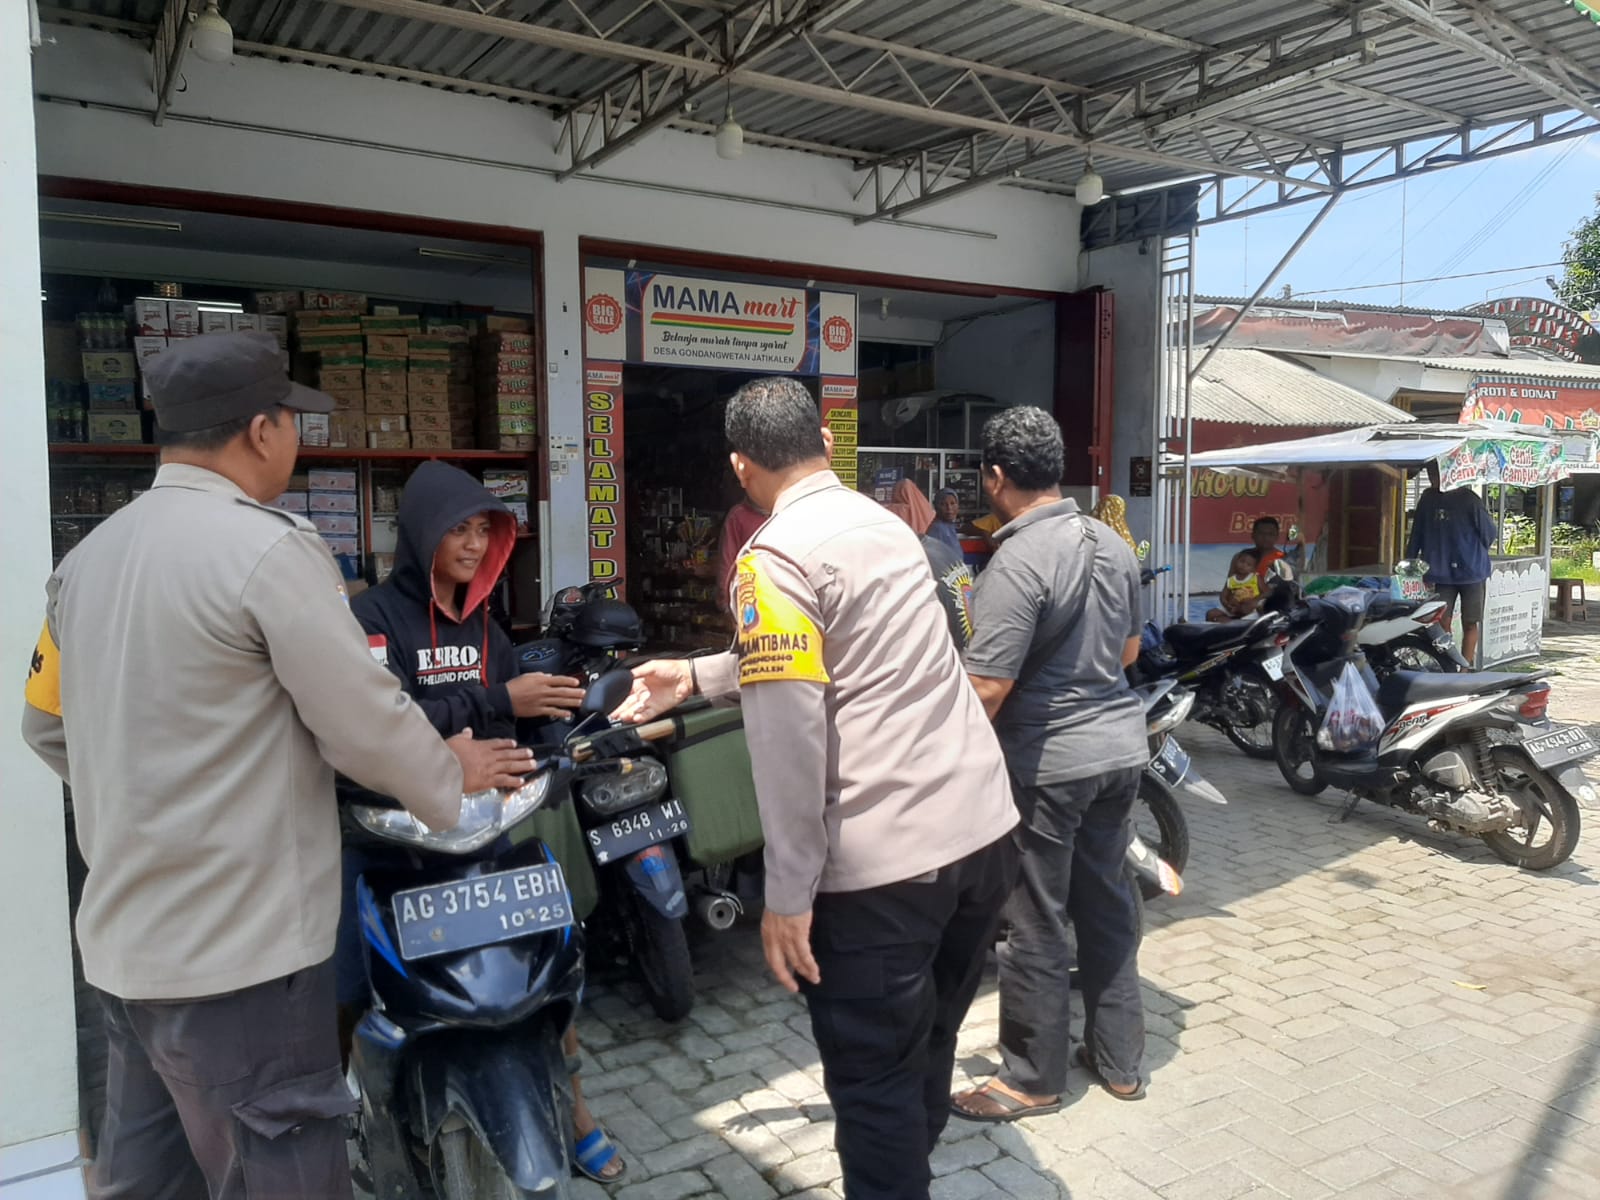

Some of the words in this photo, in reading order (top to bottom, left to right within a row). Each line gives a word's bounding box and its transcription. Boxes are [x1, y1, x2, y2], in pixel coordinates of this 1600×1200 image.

[653, 284, 740, 315] MAMA
[743, 297, 802, 318] mart
[593, 316, 615, 326] SALE
[653, 346, 677, 356] DESA
[678, 348, 750, 361] GONDANGWETAN
[751, 354, 795, 364] JATIKALEN
[662, 331, 698, 346] Belanja
[700, 335, 730, 346] murah
[732, 338, 758, 350] tanpa
[760, 341, 788, 352] syarat
[1480, 387, 1507, 397] ROTI
[1509, 388, 1519, 398] &
[1521, 389, 1558, 399] DONAT
[588, 392, 619, 548] SELAMAT
[590, 830, 601, 845] S
[611, 812, 651, 838] 6348
[660, 800, 682, 819] WI
[402, 893, 435, 924] AG
[441, 878, 508, 915] 3754
[513, 869, 562, 901] EBH
